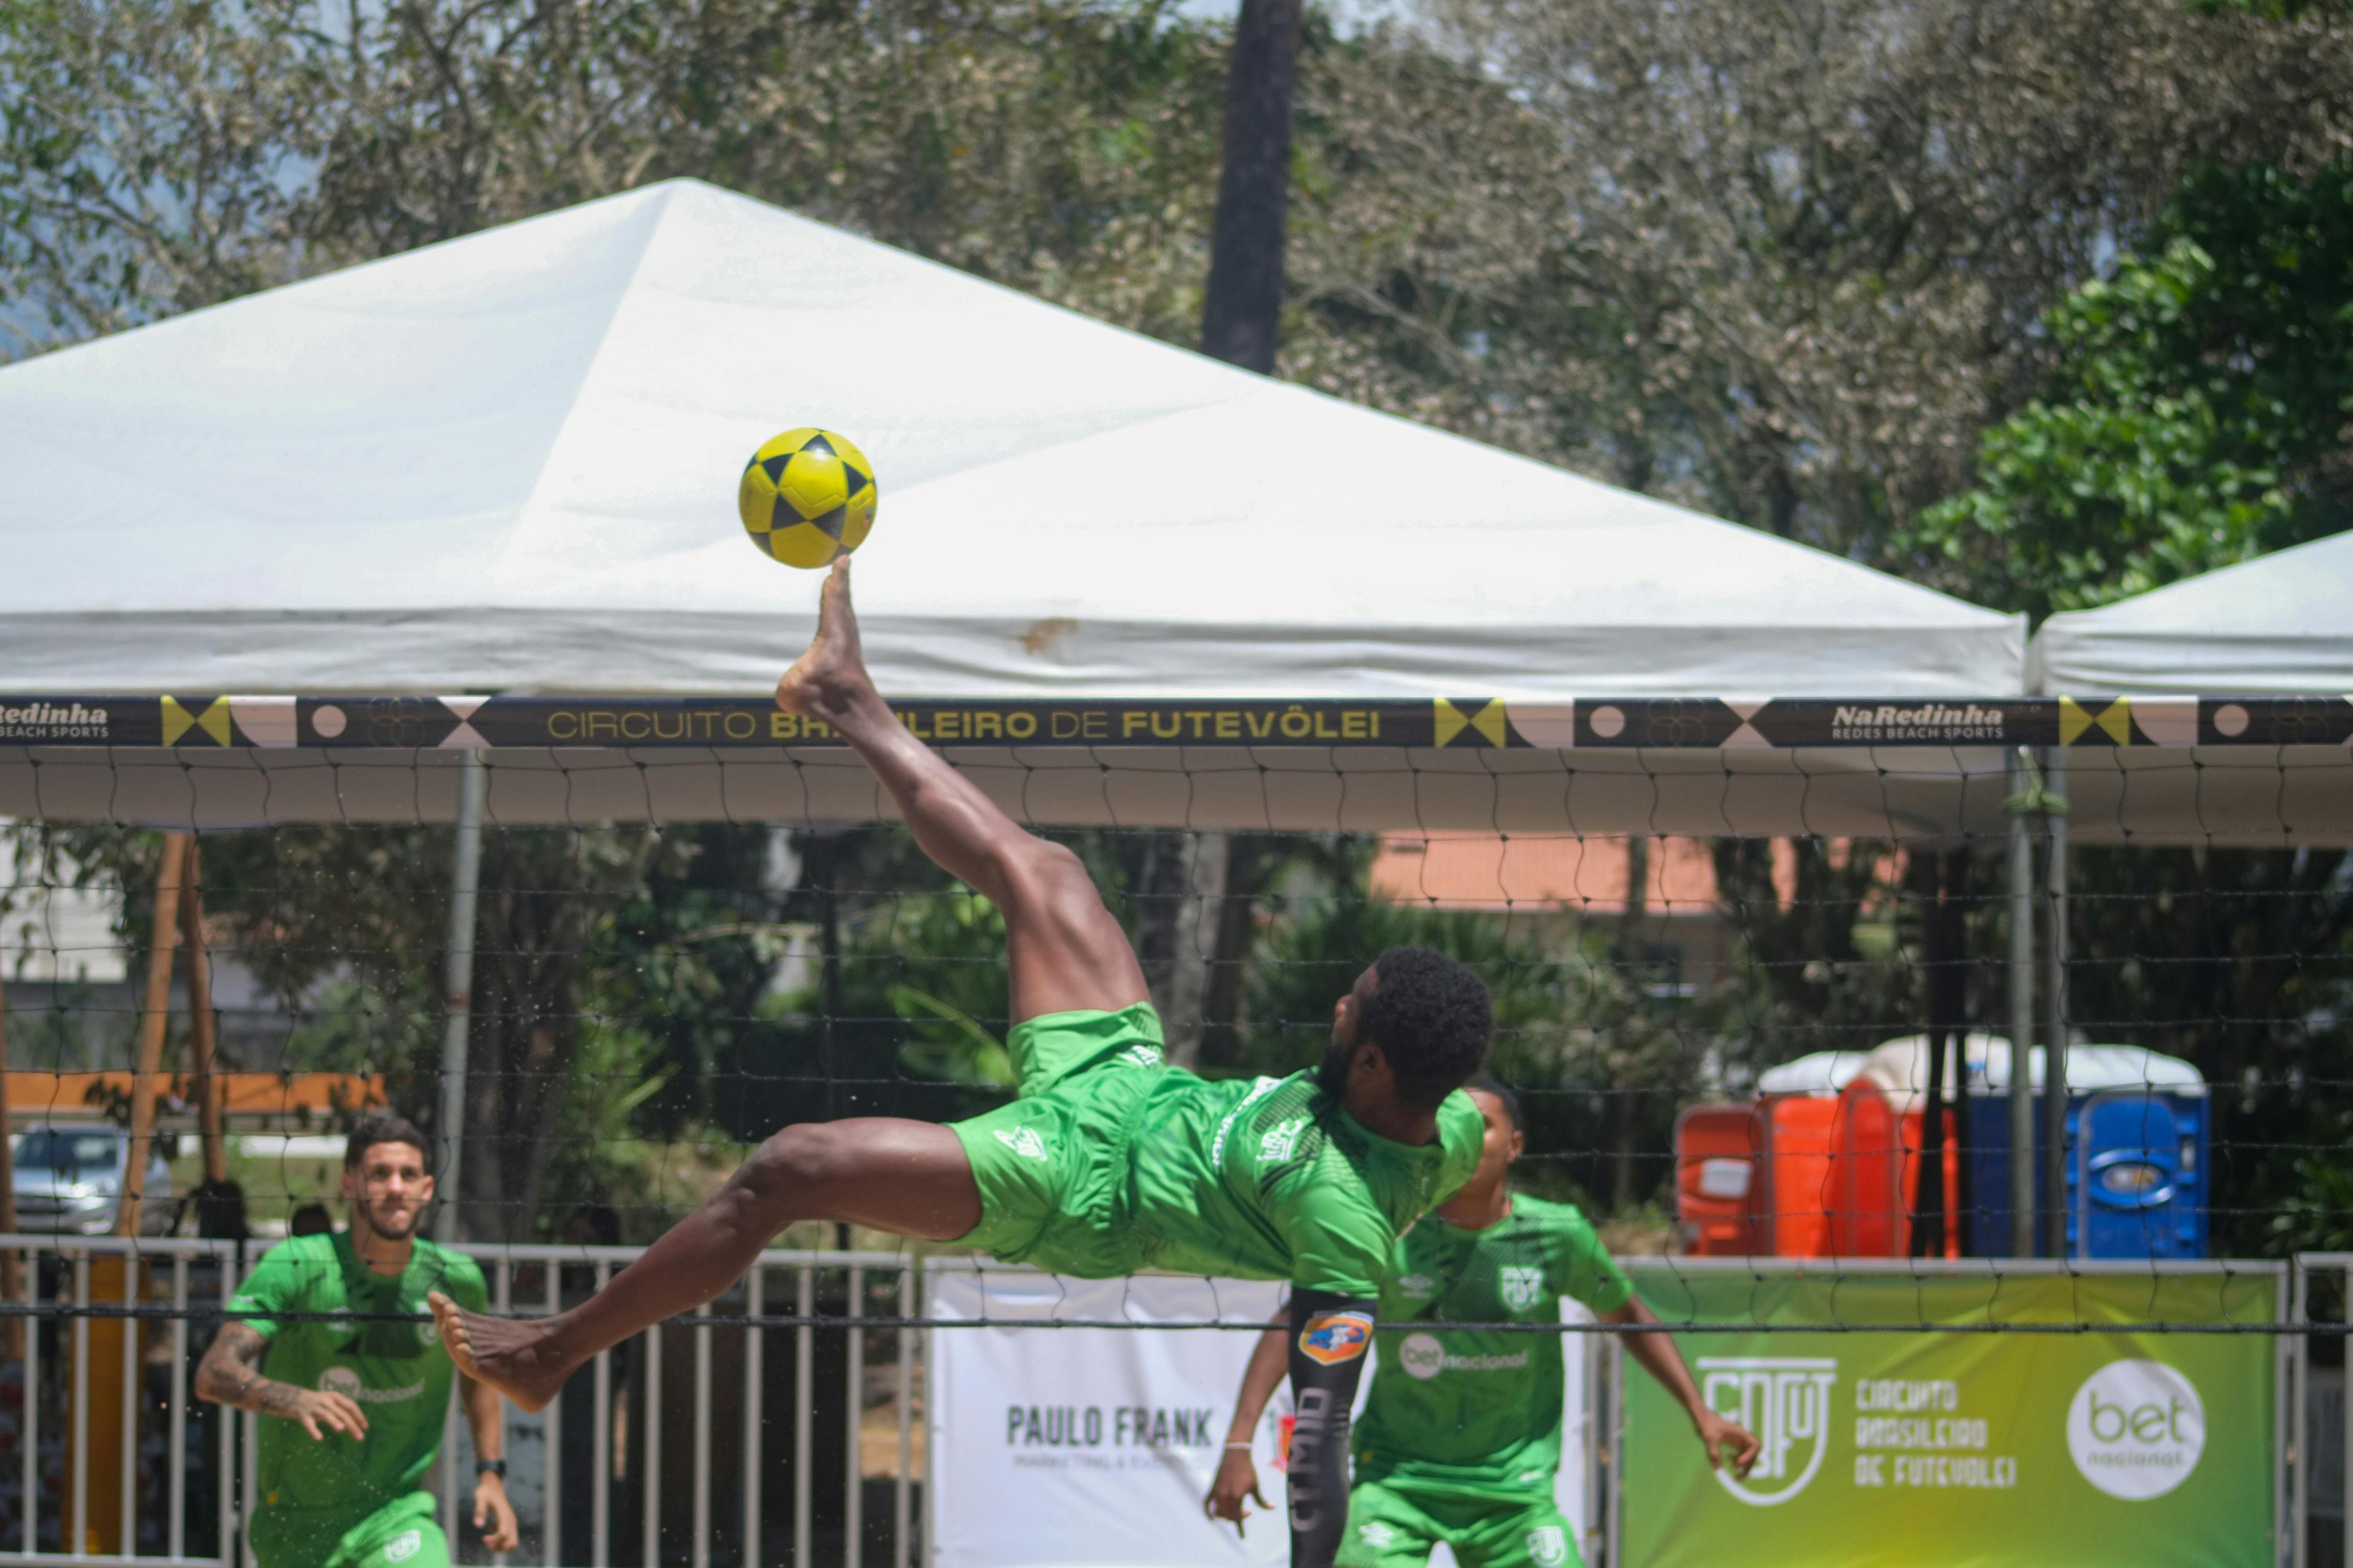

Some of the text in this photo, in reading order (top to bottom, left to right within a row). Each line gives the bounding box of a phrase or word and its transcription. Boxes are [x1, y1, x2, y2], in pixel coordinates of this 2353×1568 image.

[0, 703, 108, 724] edinha
[549, 705, 1380, 739] CIRCUITO BRLEIRO DE FUTEVÔLEI
[1831, 704, 2004, 725] NaRedinha
[52, 727, 109, 738] SPORTS
[1832, 727, 2004, 739] REDES BEACH SPORTS
[1007, 1407, 1213, 1447] PAULO FRANK
[2089, 1390, 2186, 1445] bet
